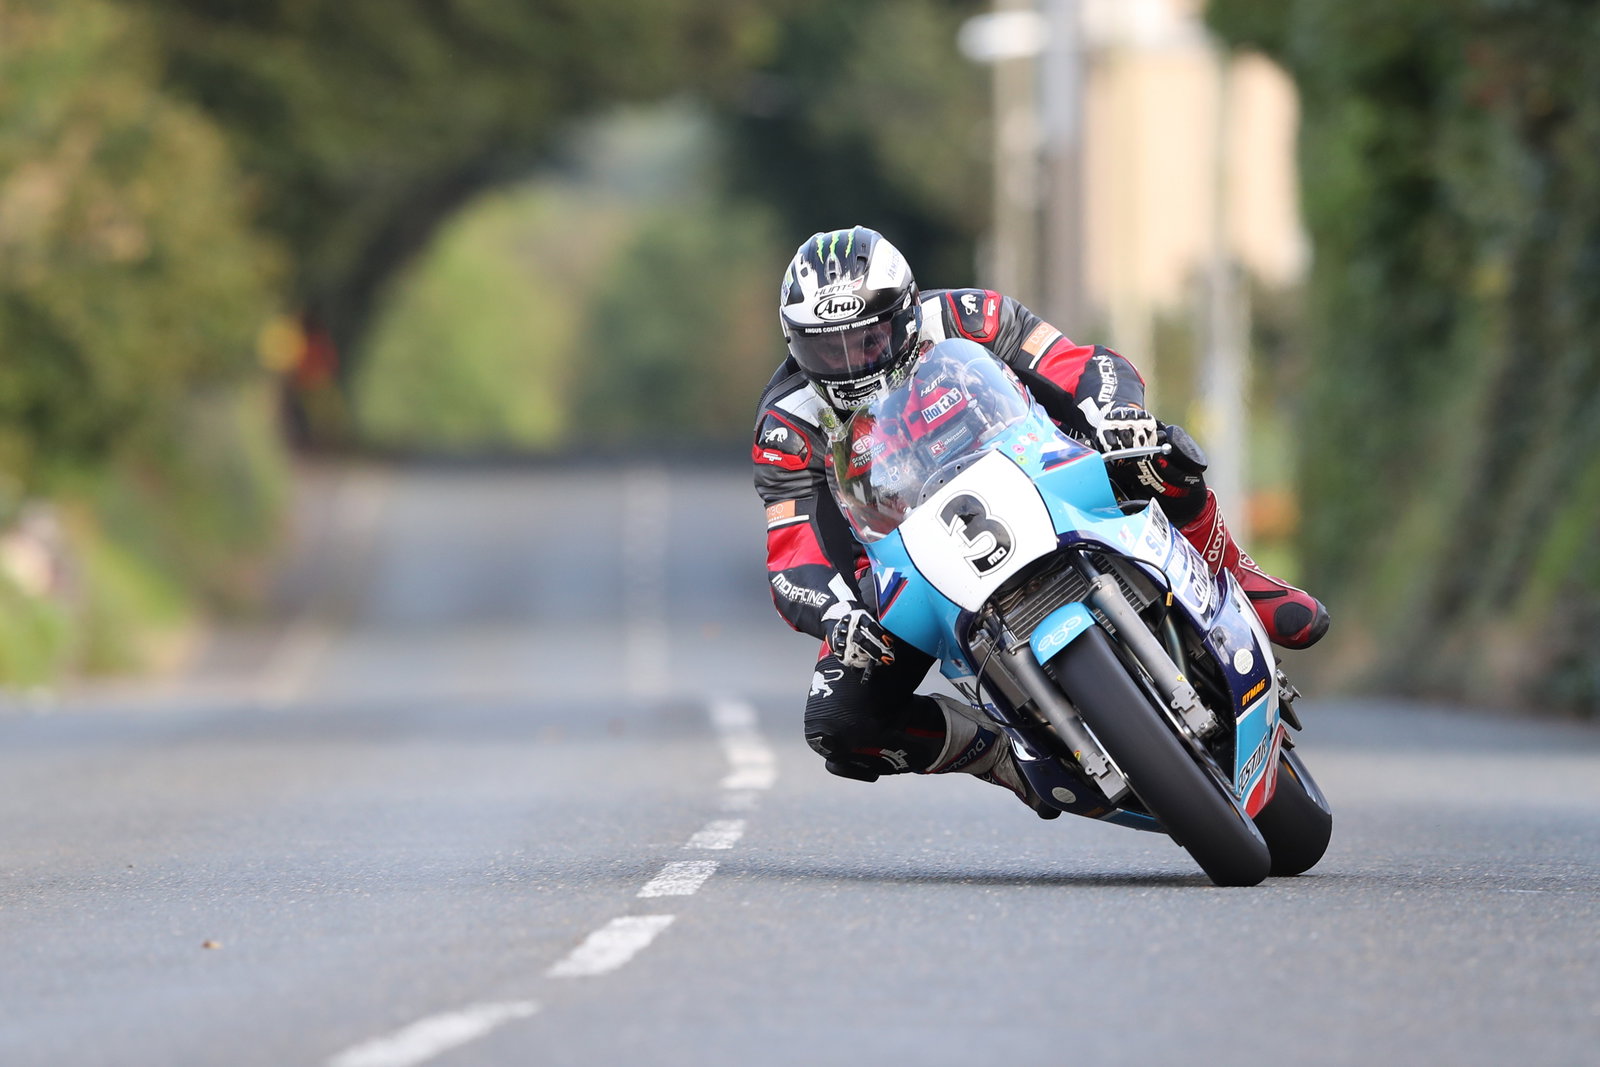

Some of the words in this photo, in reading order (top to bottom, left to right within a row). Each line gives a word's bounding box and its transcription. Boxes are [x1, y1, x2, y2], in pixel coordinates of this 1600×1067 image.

[817, 298, 858, 317] Arai
[823, 324, 850, 334] COUNTRY
[851, 316, 879, 329] WINDOWS
[936, 490, 1015, 578] 3
